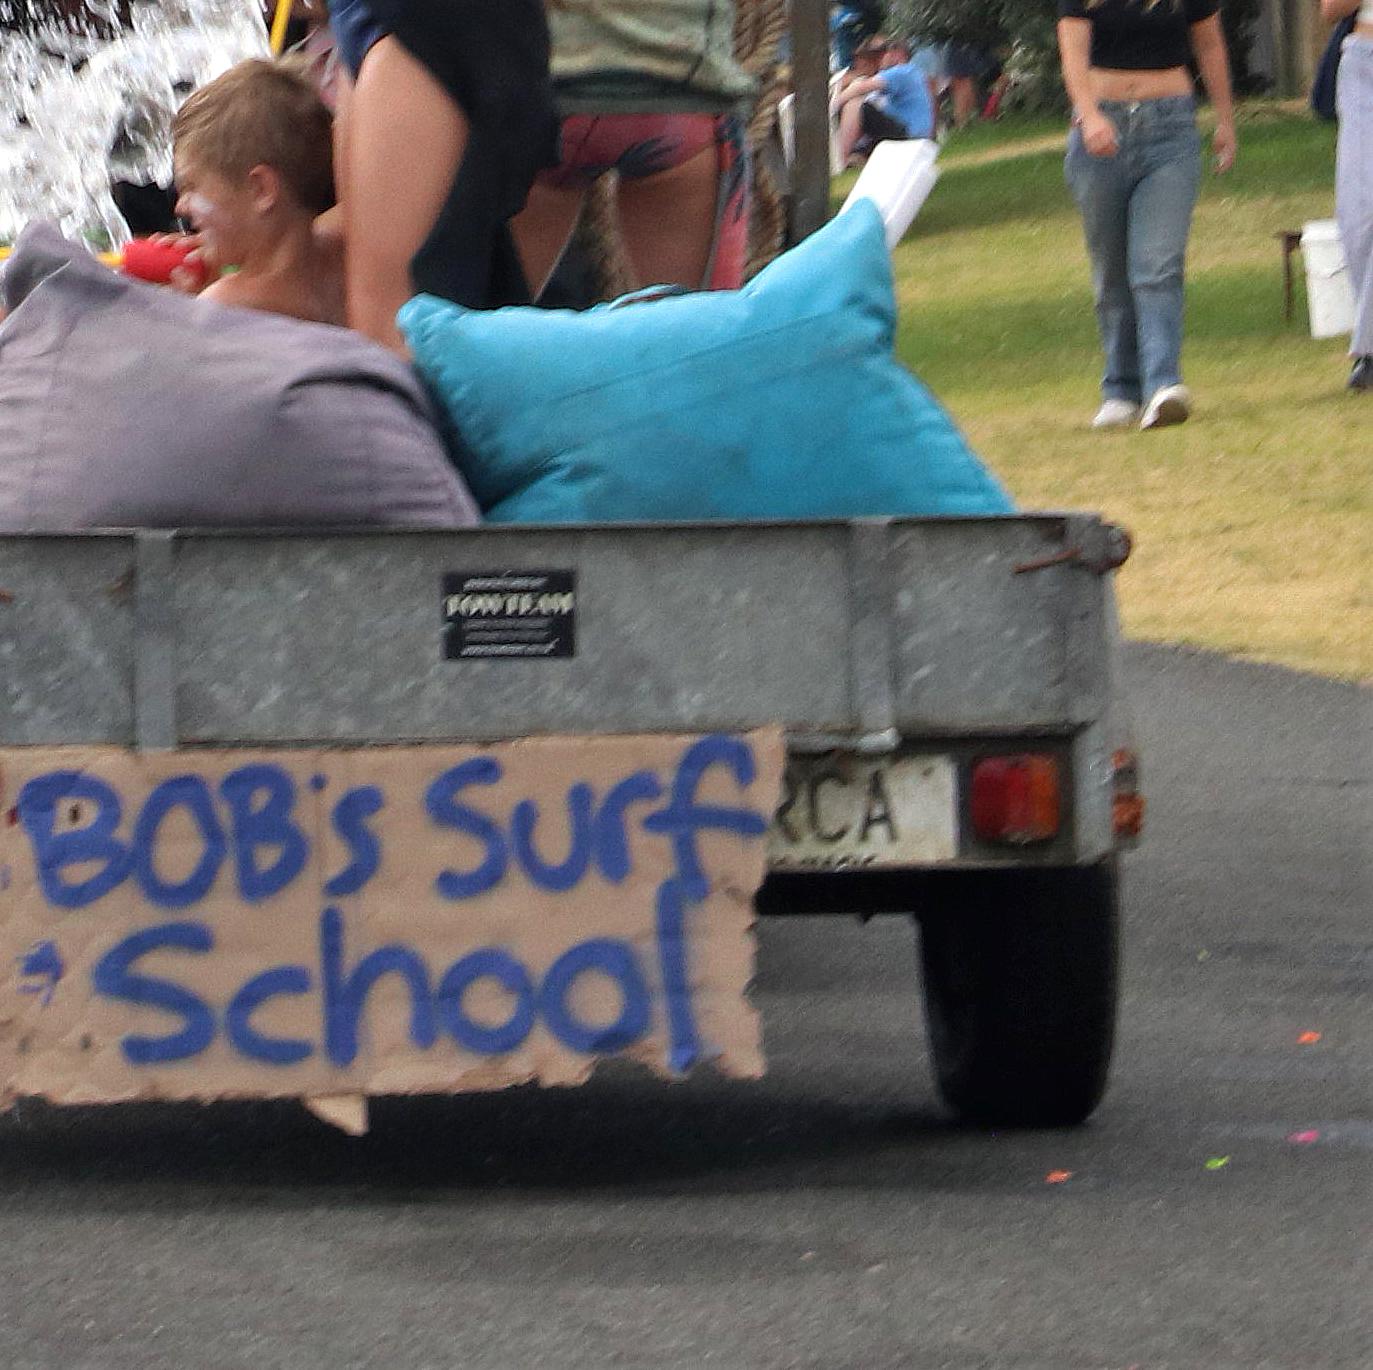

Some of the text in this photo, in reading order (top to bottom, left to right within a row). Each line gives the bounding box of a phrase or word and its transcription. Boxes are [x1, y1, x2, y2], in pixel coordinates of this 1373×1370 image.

[18, 734, 768, 910] BOB's Surf
[92, 879, 706, 1076] School
